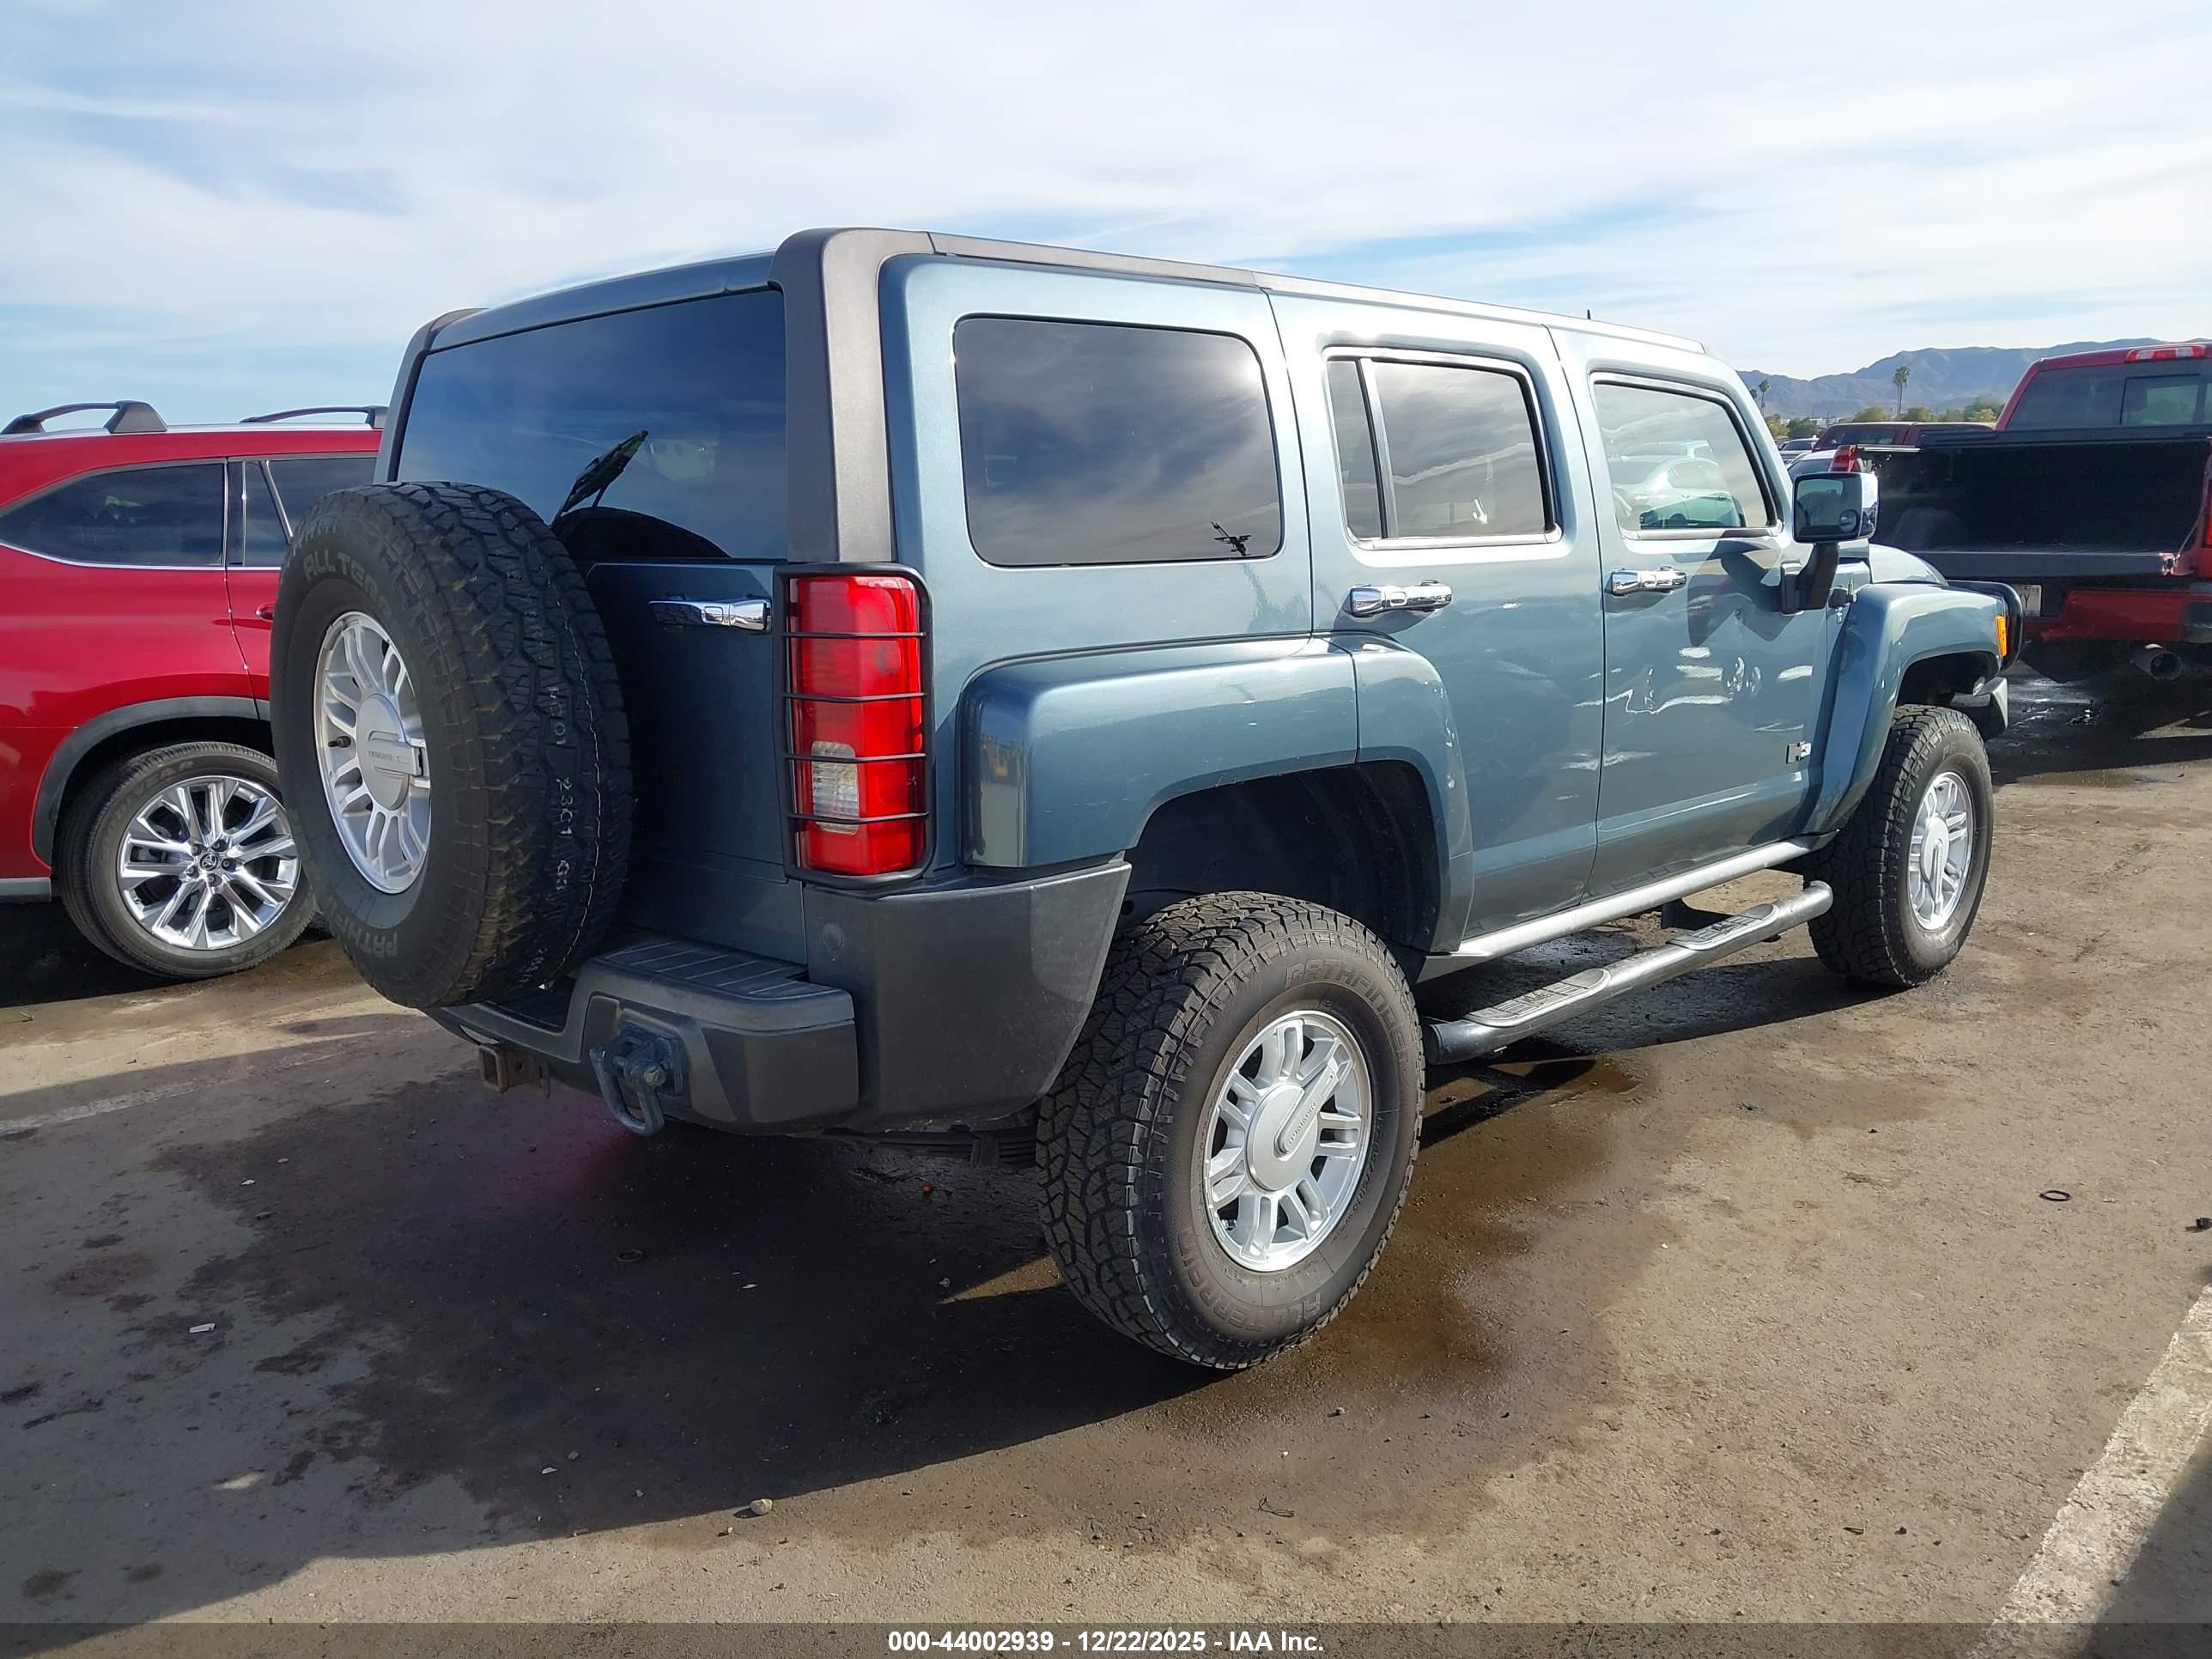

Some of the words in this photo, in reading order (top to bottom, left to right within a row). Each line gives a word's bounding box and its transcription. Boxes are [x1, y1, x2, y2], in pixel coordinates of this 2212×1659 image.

[301, 545, 337, 586] ALL
[1285, 956, 1411, 1073] PATHFINDER
[1272, 1291, 1322, 1331] ALL
